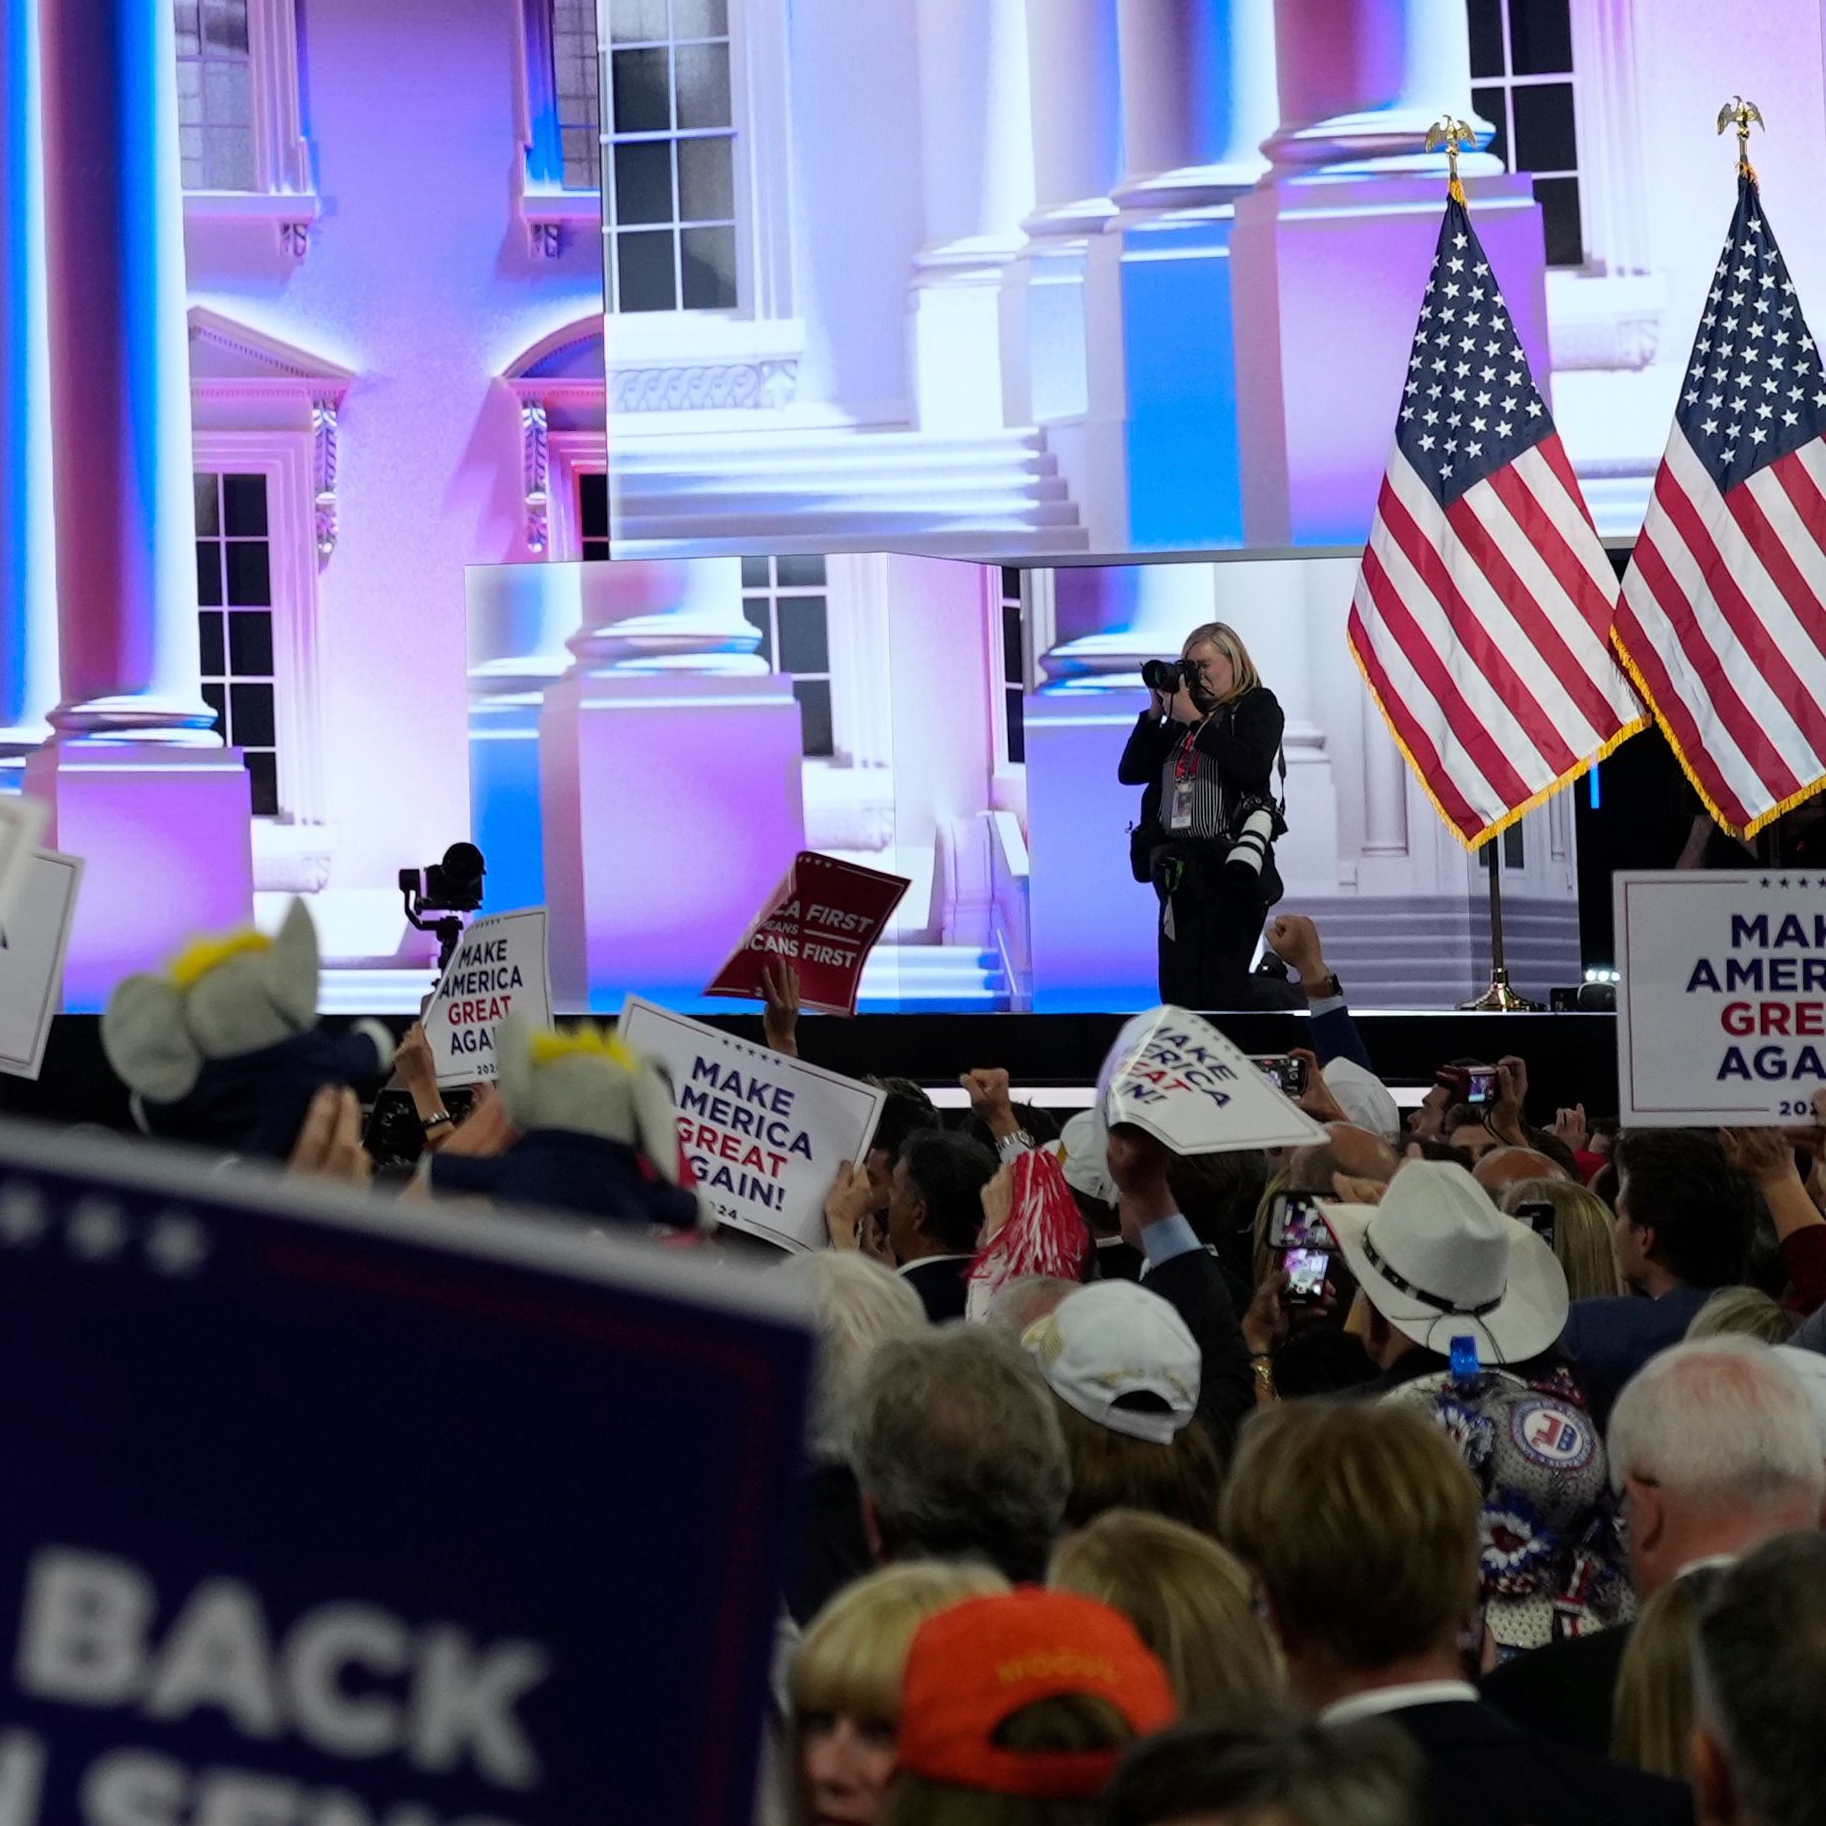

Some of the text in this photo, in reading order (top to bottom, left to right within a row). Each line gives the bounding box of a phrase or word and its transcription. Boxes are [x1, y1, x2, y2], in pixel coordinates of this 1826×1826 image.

[805, 904, 875, 934] FIRST
[459, 939, 508, 969] MAKE
[803, 944, 857, 968] FIRST
[439, 966, 523, 999] AMERICA
[448, 995, 511, 1026] GREAT
[691, 1056, 795, 1118] MAKE
[676, 1116, 788, 1179] GREAT
[15, 1542, 552, 1792] BACK
